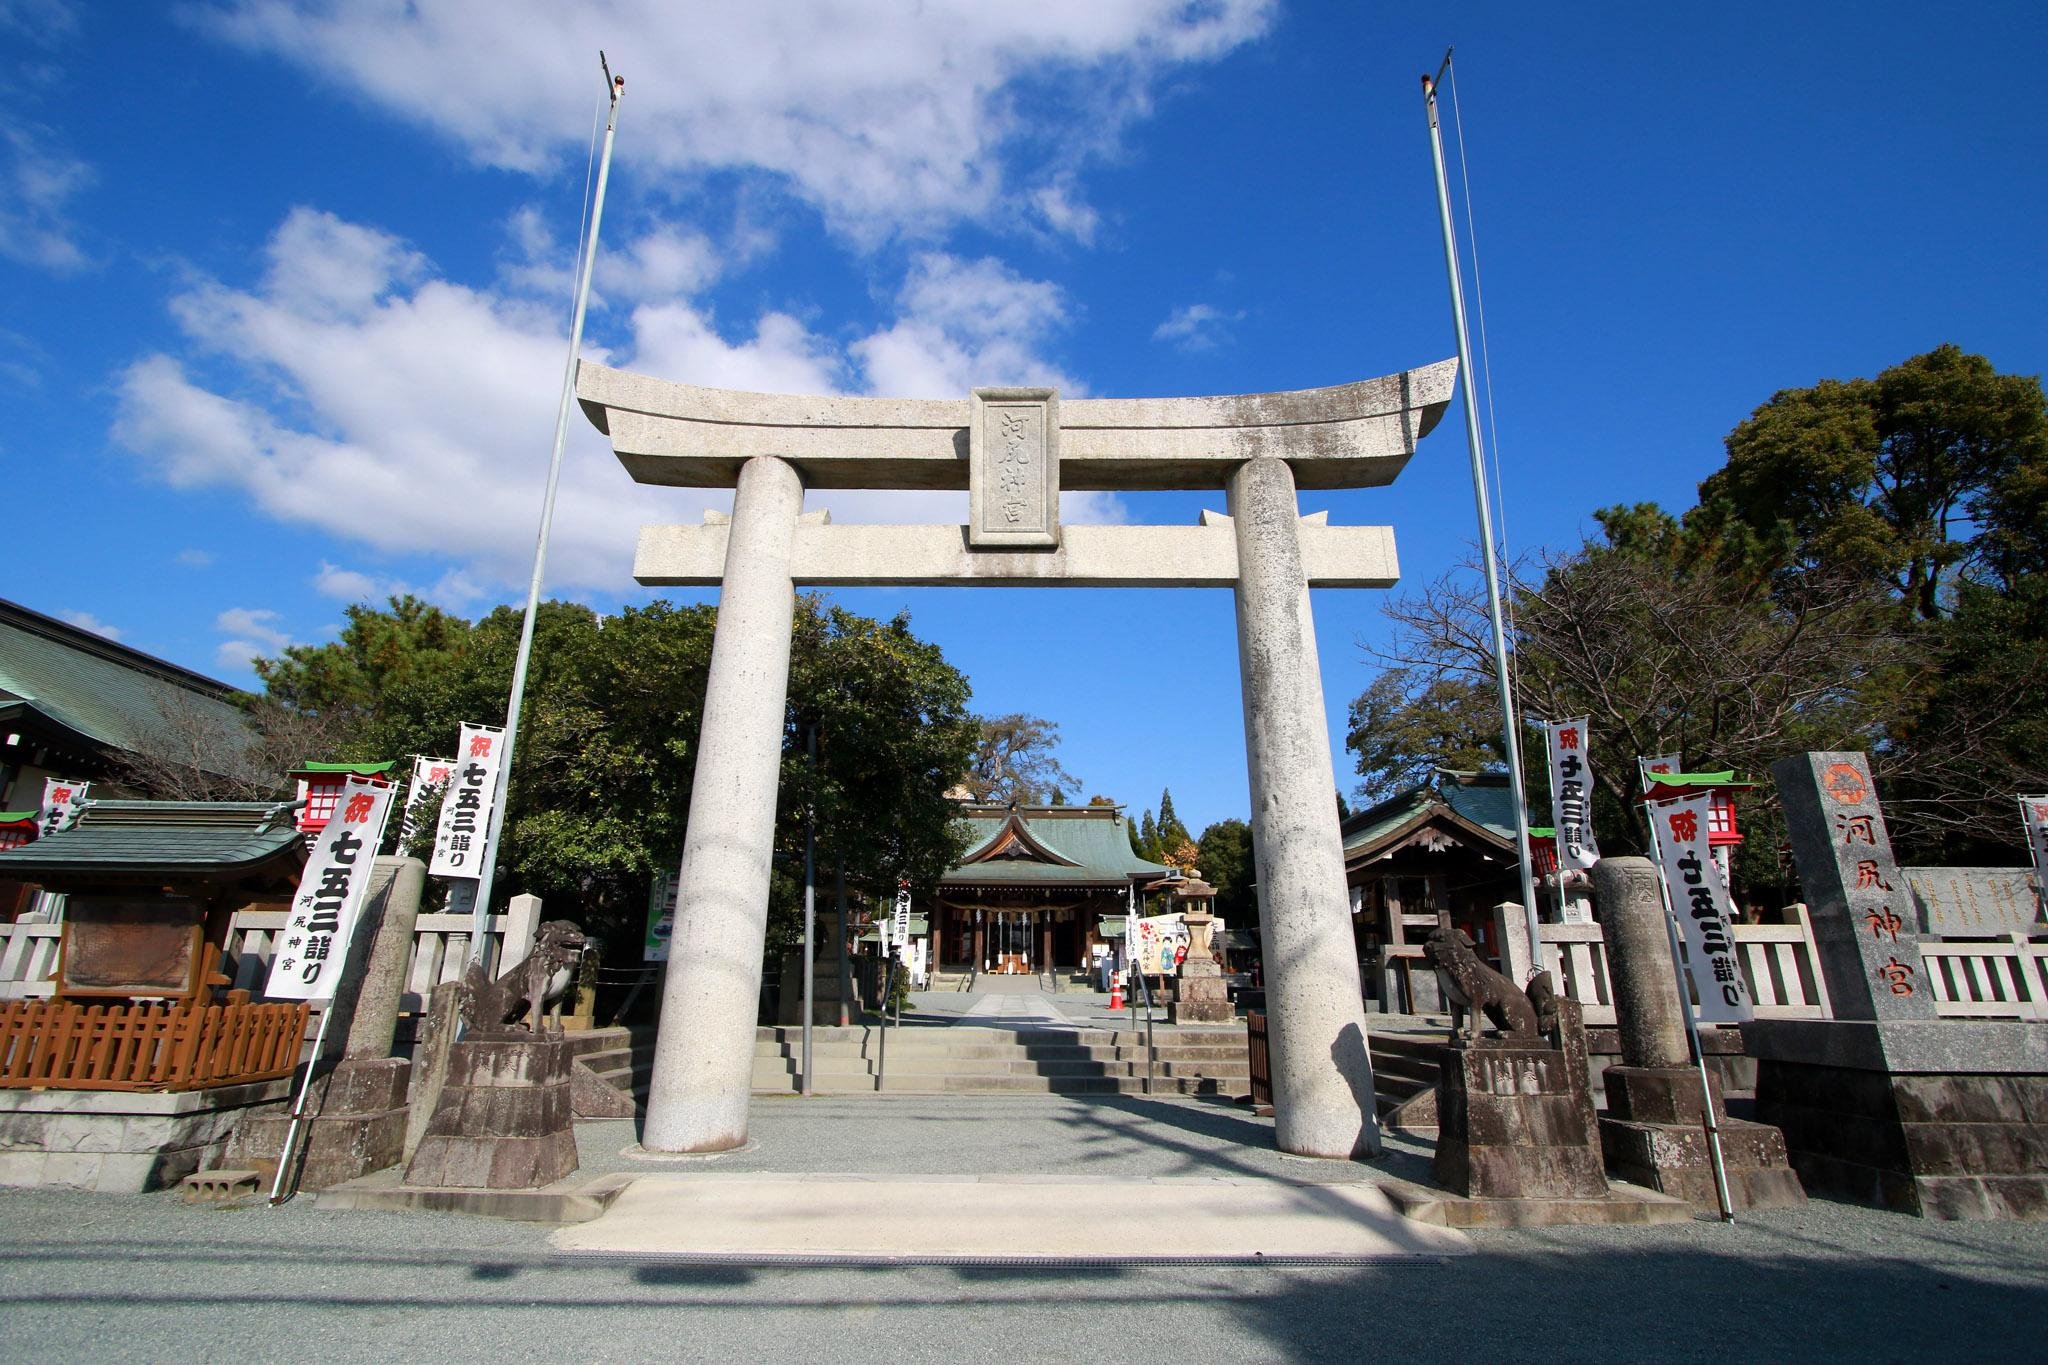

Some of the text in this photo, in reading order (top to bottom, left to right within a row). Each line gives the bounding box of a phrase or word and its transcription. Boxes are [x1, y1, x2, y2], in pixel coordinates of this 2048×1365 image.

[998, 413, 1030, 523] 河尻神宮
[52, 787, 72, 804] 祝
[344, 792, 375, 824] 祝
[437, 806, 455, 858] 河尻神宮
[450, 735, 492, 867] 祝 七五三詣り
[282, 895, 314, 971] 河尻神宮
[302, 831, 363, 985] 七五三詣り
[1836, 813, 1914, 996] 河尻神宮
